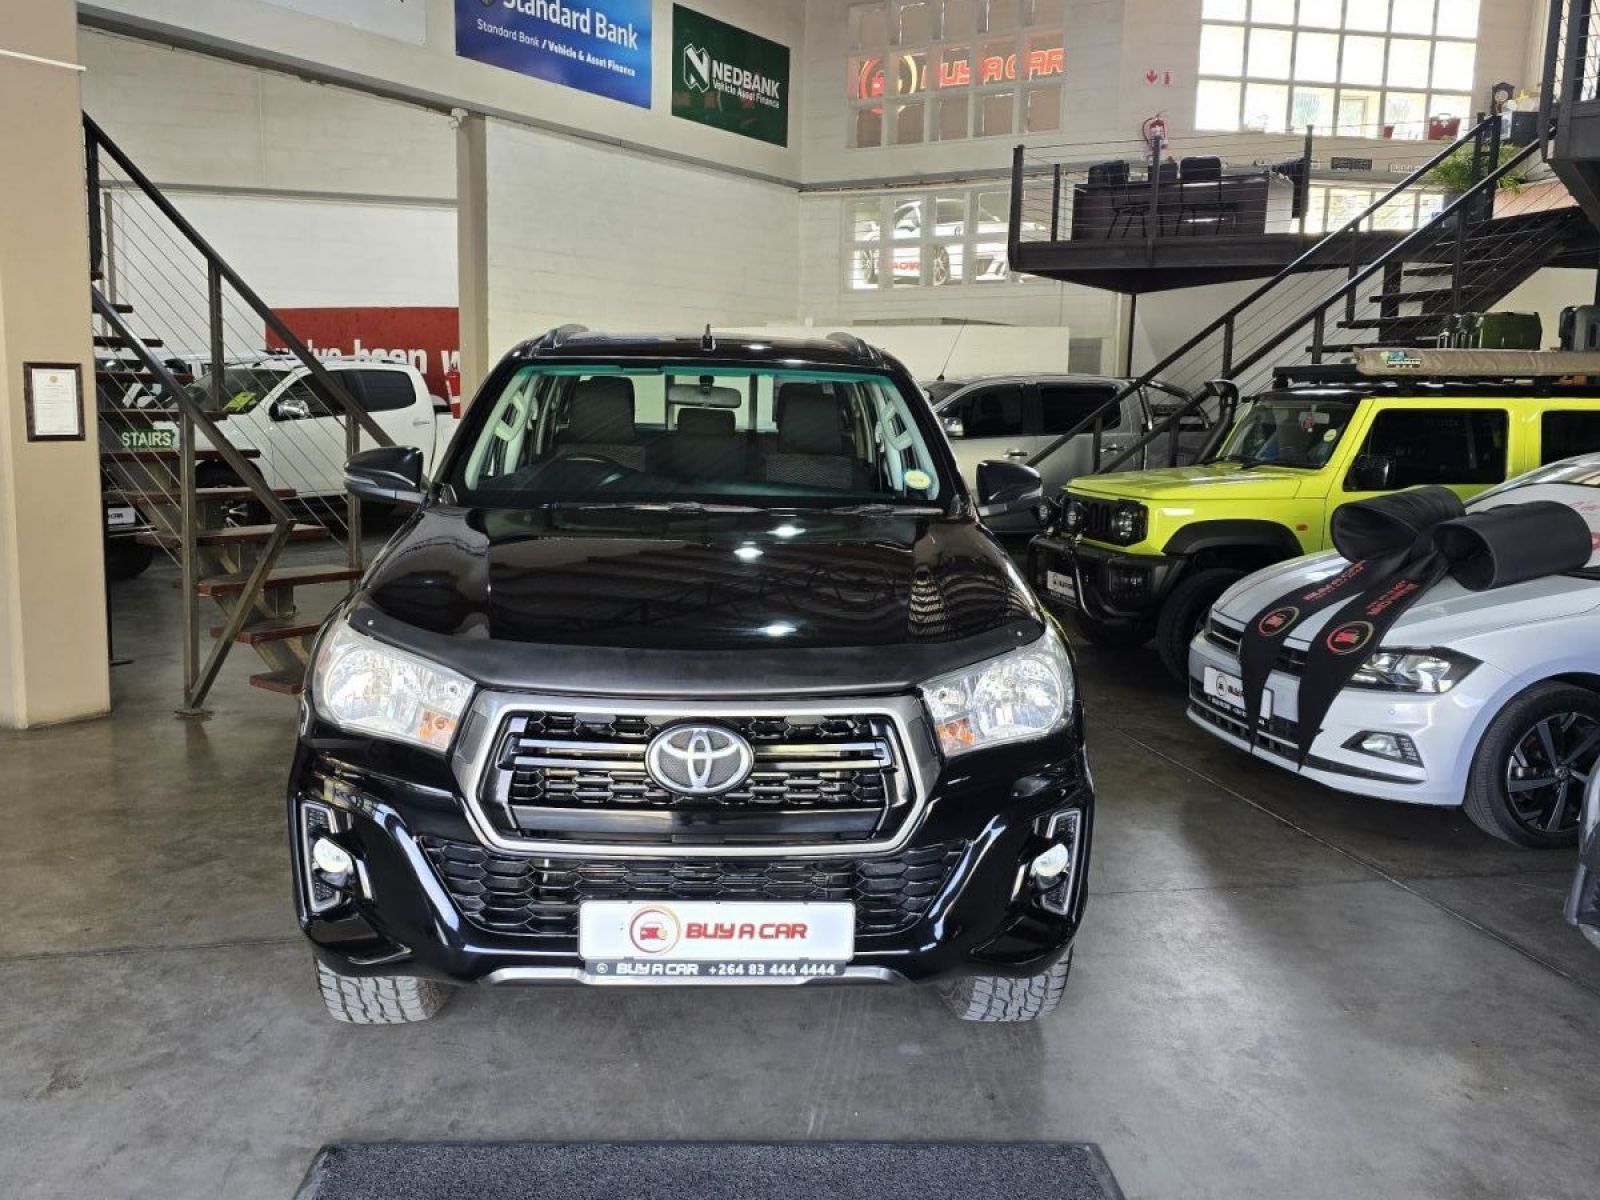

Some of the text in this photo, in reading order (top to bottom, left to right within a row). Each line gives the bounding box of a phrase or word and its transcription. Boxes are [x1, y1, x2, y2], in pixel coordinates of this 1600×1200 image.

[595, 11, 638, 50] Bank
[476, 18, 517, 41] Standard
[518, 31, 540, 47] Bank
[548, 40, 577, 60] Vehicle
[578, 50, 585, 61] &
[586, 54, 607, 69] Asset
[607, 60, 636, 77] Finance
[711, 59, 780, 99] NEDBANK
[712, 78, 737, 96] Vehicle
[755, 92, 780, 109] Finance
[121, 431, 172, 447] STAIRS
[685, 922, 808, 939] BUY A CAR
[616, 963, 836, 975] BUY A CAR +264 83 444 4444
